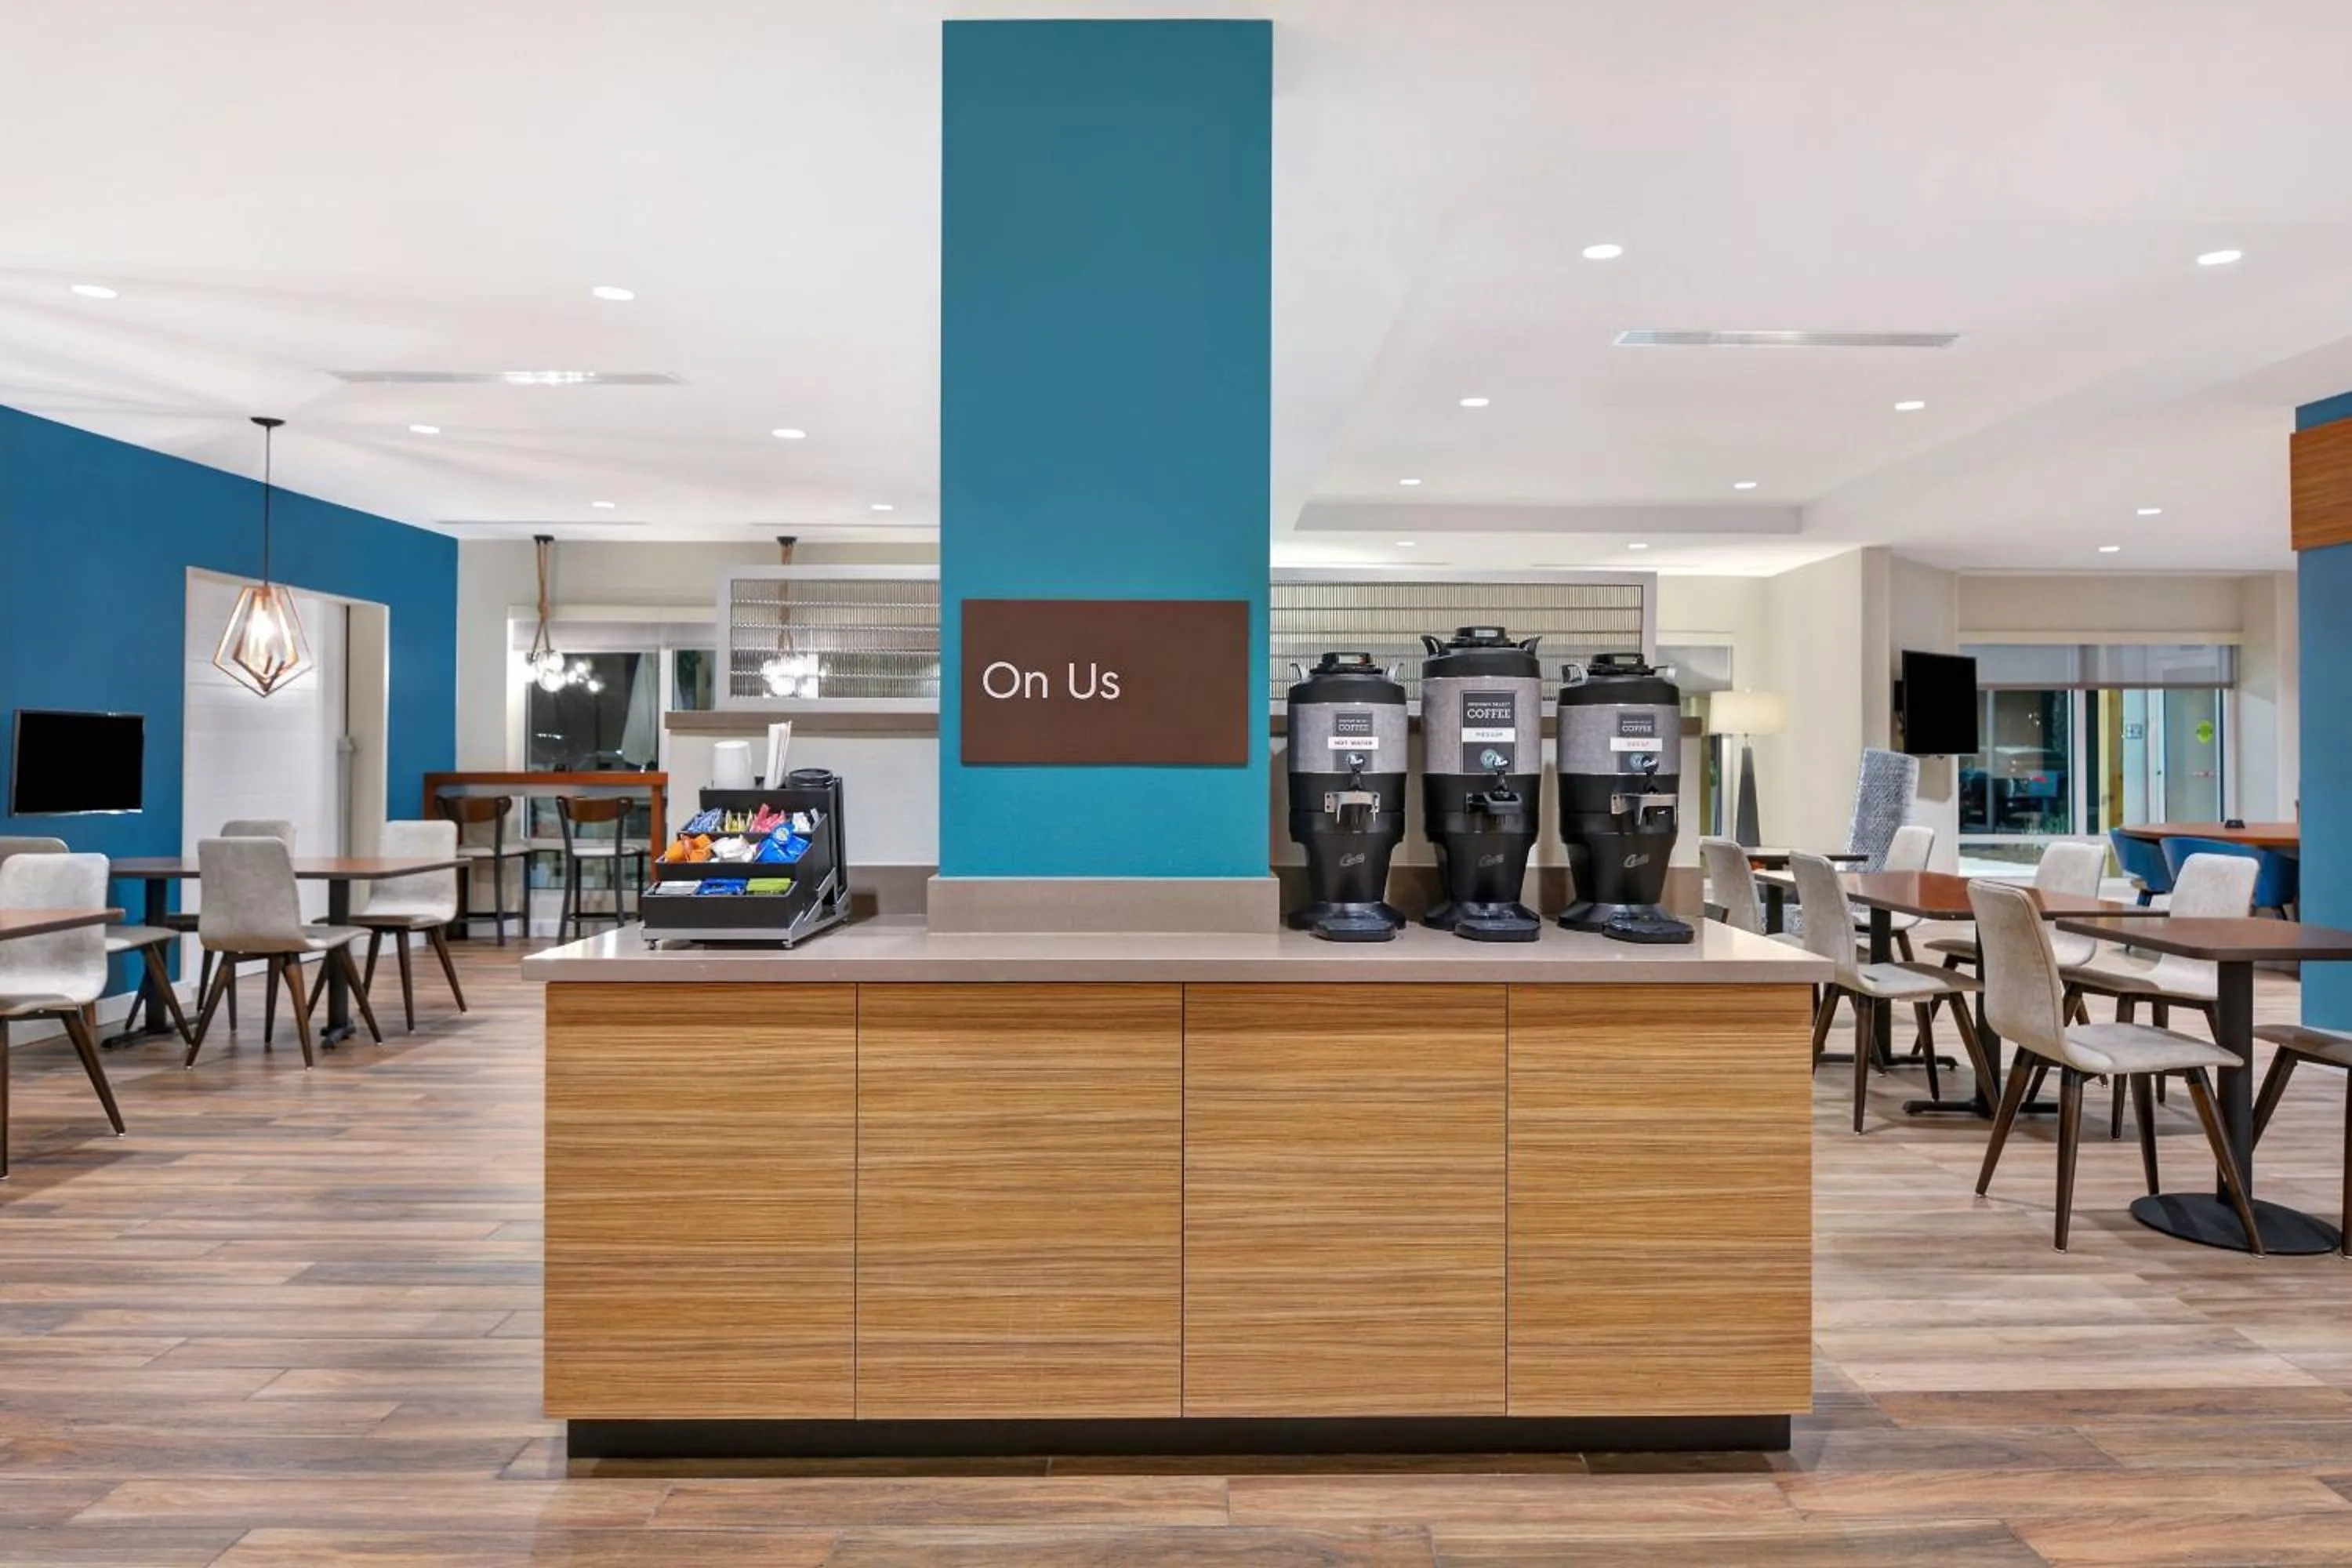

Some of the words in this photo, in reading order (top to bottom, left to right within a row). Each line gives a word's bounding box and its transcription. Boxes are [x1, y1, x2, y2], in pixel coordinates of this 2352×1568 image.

[982, 661, 1048, 699] On
[1069, 662, 1120, 700] Us
[1467, 708, 1511, 719] COFFEE
